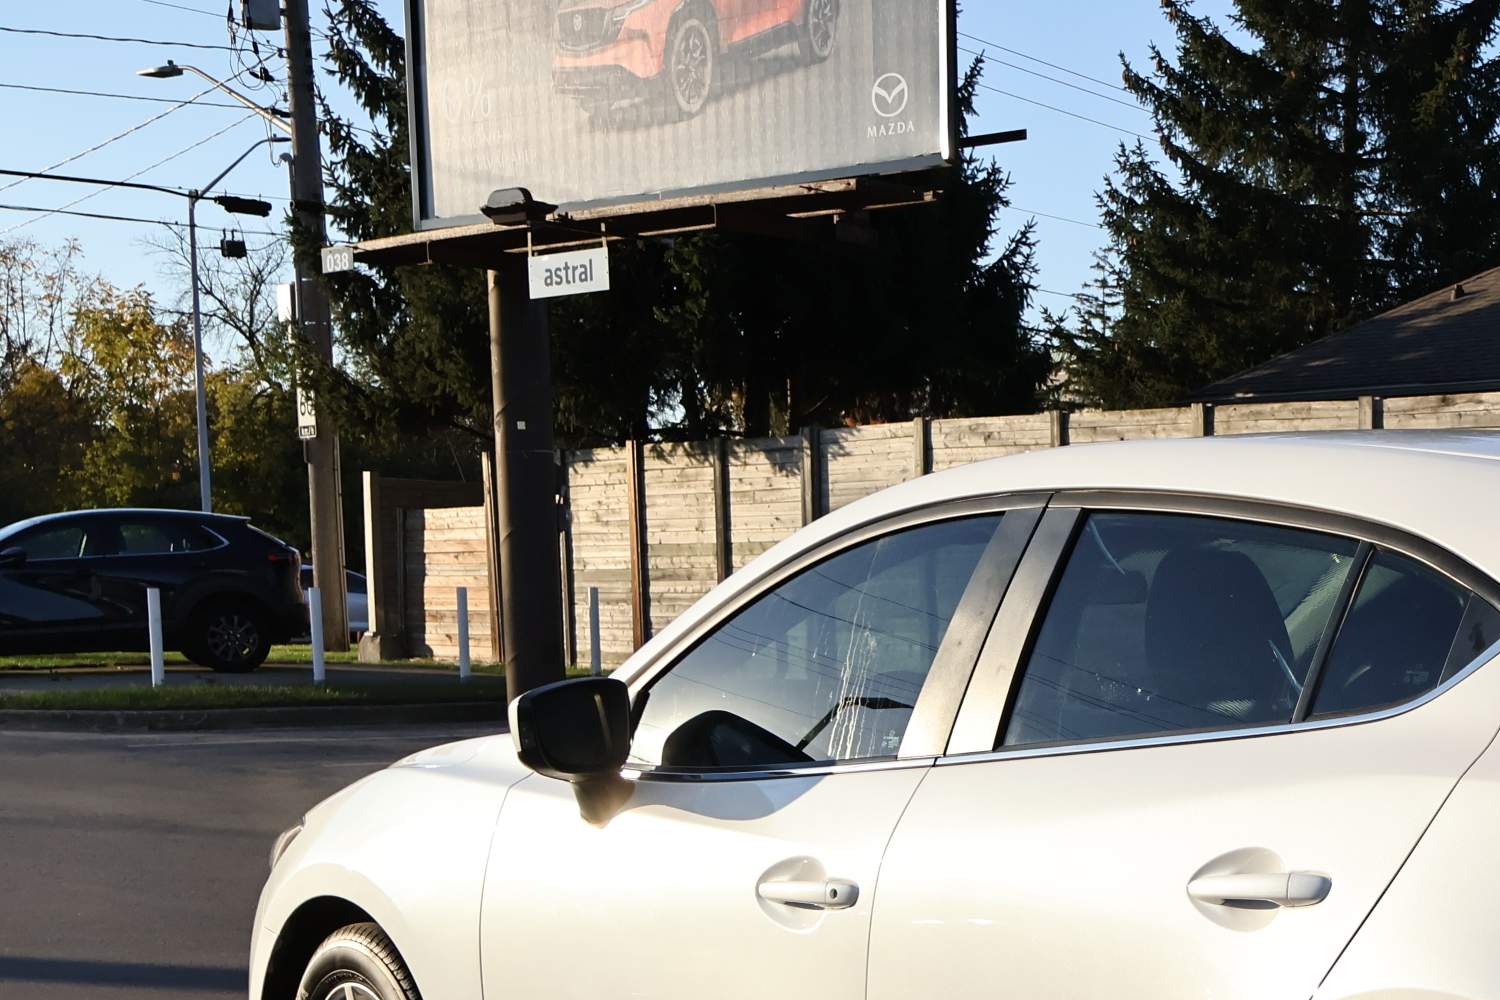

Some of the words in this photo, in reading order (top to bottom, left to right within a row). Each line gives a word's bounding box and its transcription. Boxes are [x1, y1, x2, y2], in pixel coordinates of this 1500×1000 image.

[866, 120, 915, 138] MAZDA
[326, 252, 349, 272] 038
[544, 258, 594, 287] astral
